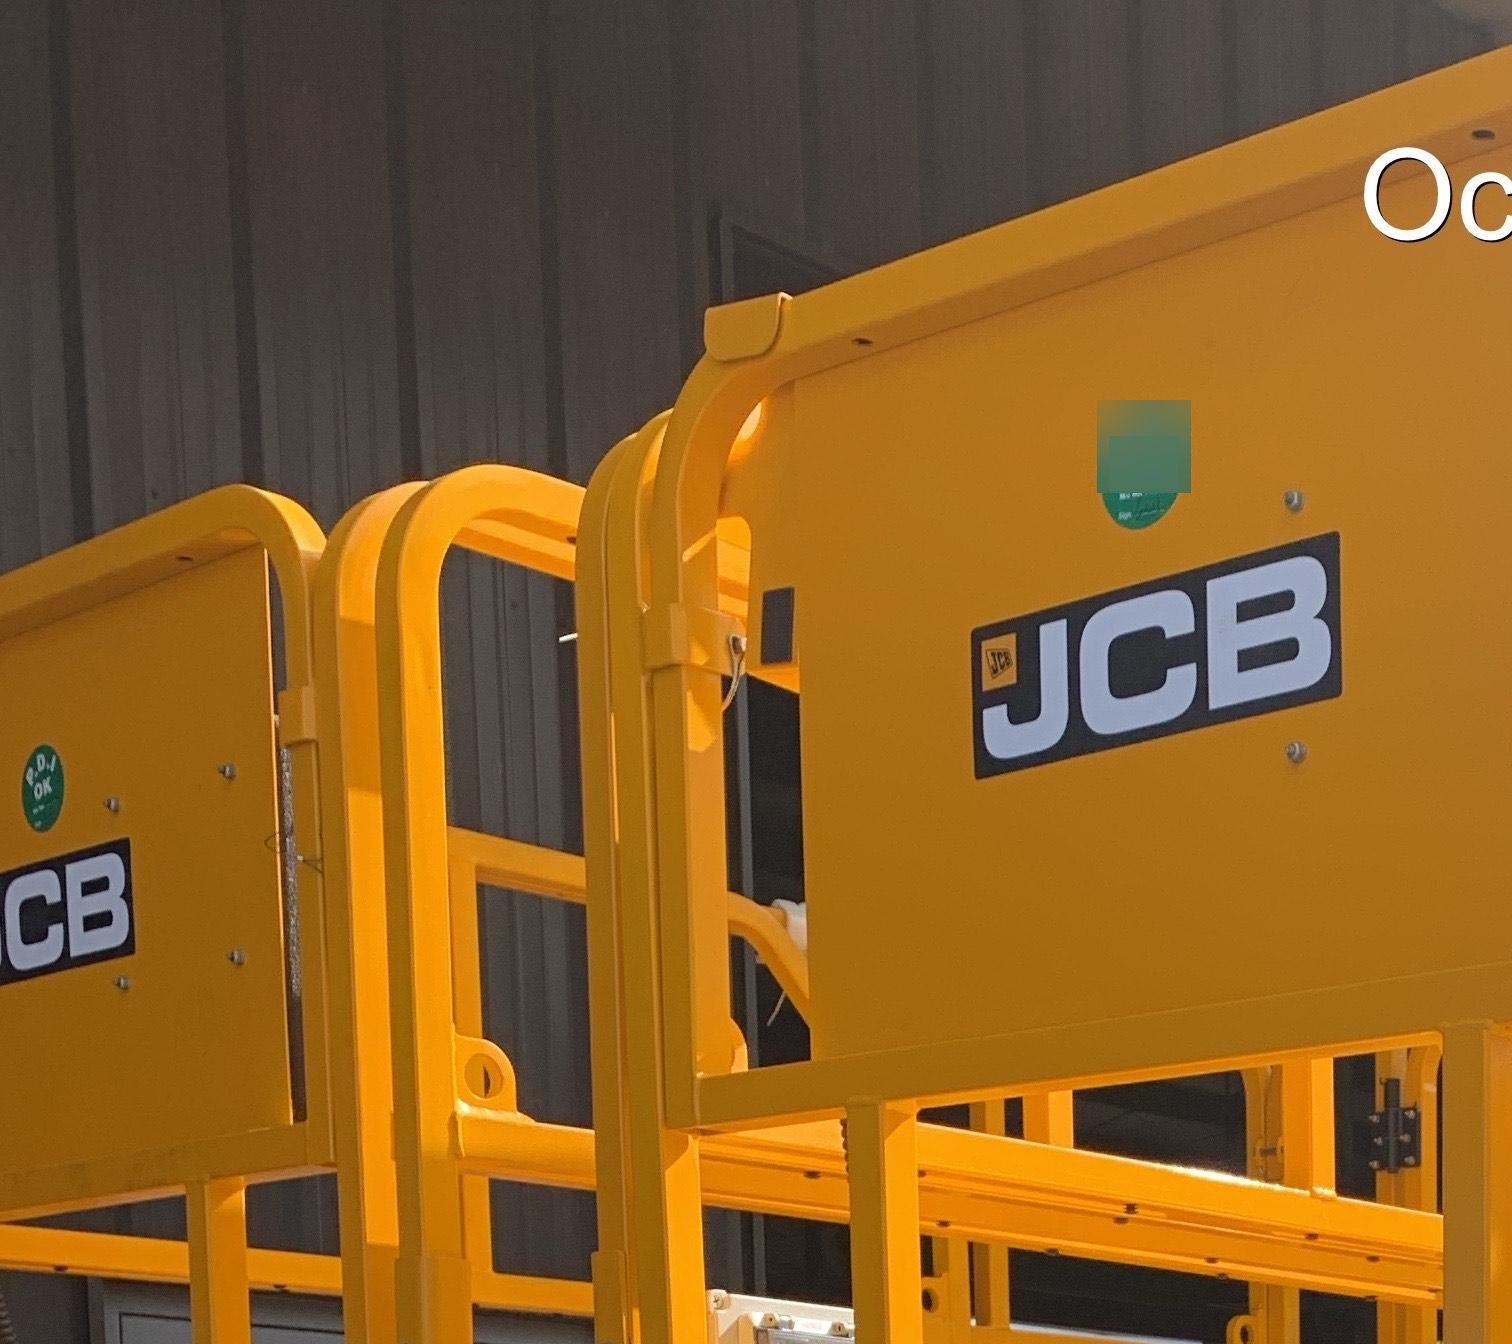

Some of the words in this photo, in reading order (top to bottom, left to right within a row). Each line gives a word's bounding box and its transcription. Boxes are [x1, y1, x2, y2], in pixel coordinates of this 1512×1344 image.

[982, 555, 1331, 760] JCB
[34, 776, 53, 801] OK
[0, 852, 129, 971] CB
